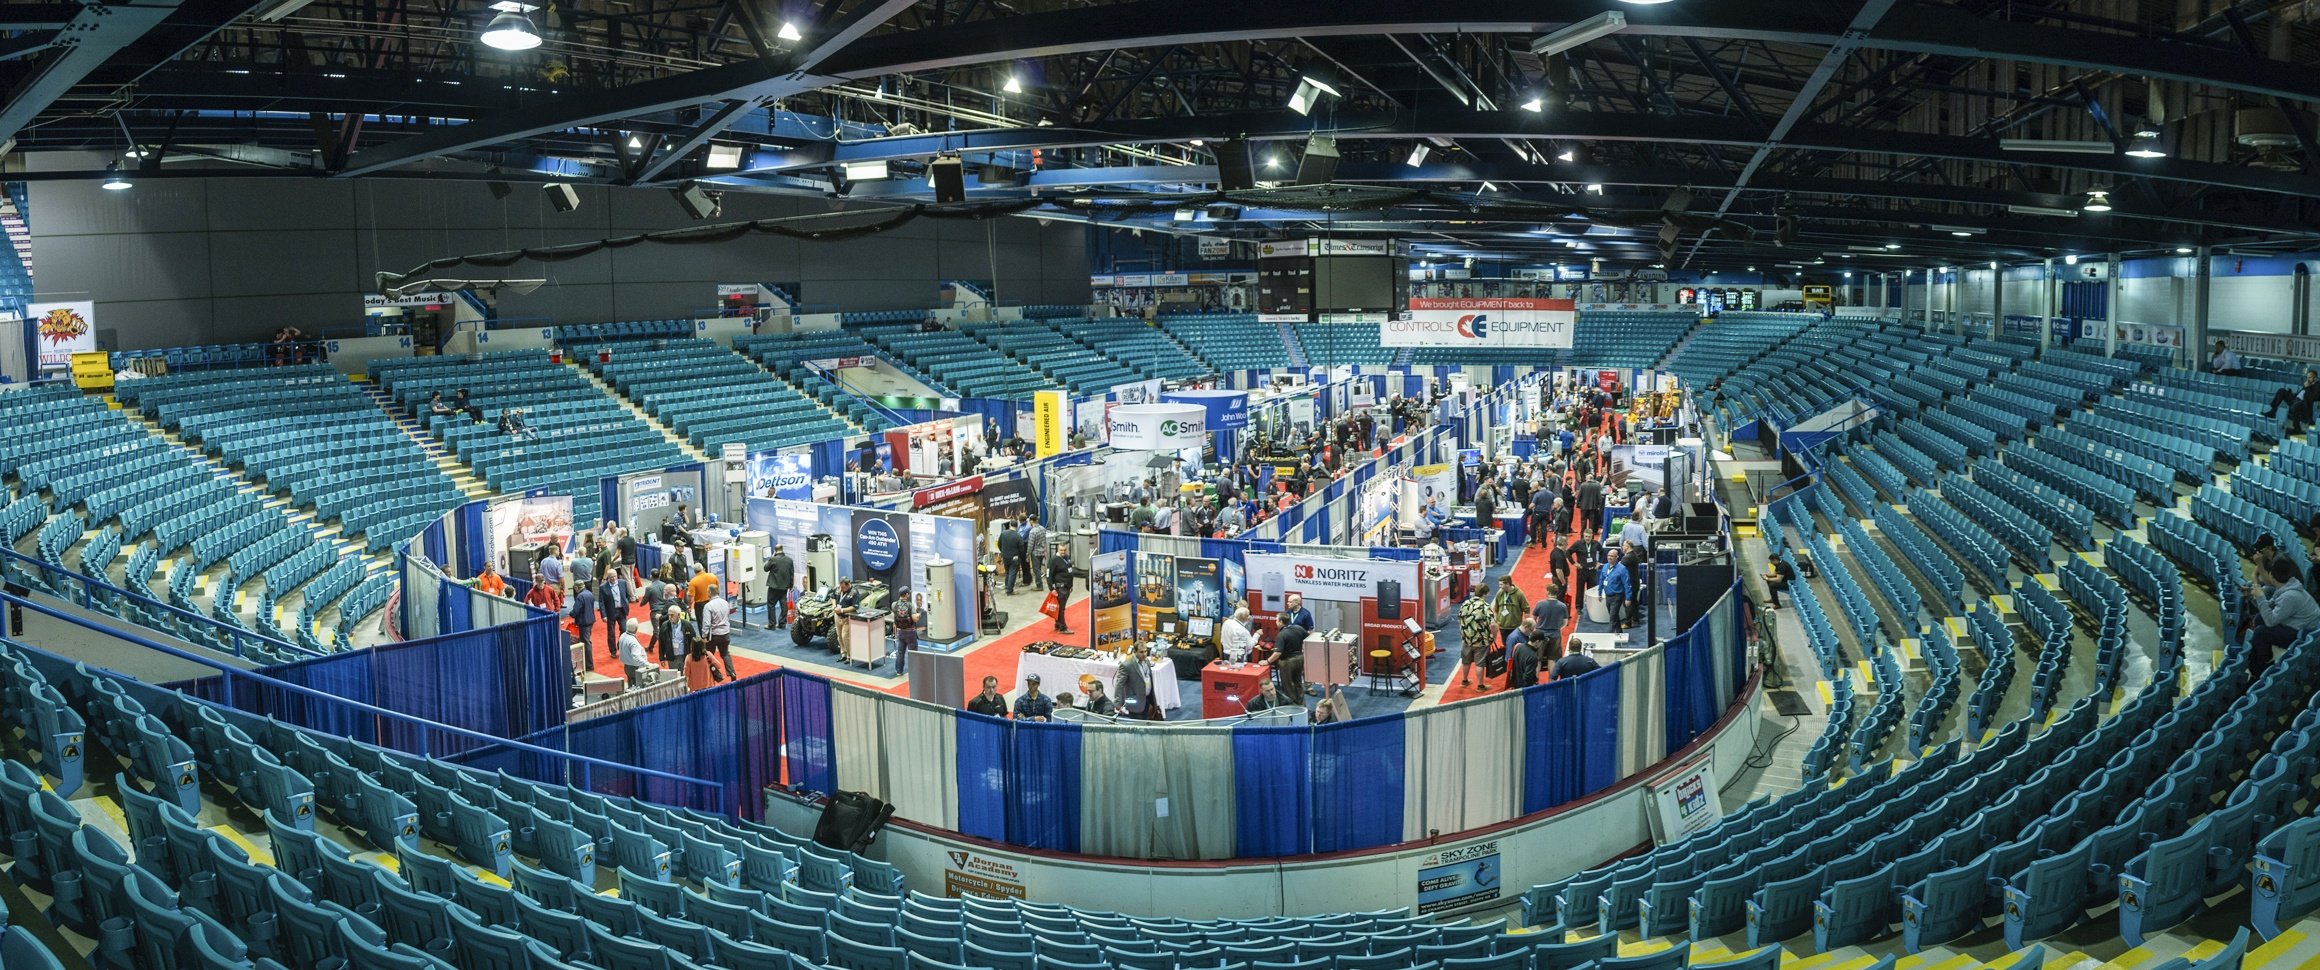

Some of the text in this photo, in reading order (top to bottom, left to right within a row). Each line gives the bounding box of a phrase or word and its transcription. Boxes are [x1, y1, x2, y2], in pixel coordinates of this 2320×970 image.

[365, 297, 392, 305] oday's
[414, 295, 436, 303] Music
[1420, 300, 1431, 308] We
[1433, 300, 1460, 310] brought
[1508, 300, 1524, 308] back
[698, 321, 706, 331] 13
[744, 319, 751, 327] 12
[1389, 321, 1454, 332] CONTROLS
[1491, 322, 1565, 333] EQUIPMENT
[477, 332, 488, 343] 14
[541, 329, 551, 339] 13
[326, 341, 339, 352] 15
[399, 337, 411, 348] 14
[2231, 335, 2282, 354] DELIVERING
[40, 353, 72, 364] WILDC
[1221, 413, 1236, 422] John
[1043, 413, 1051, 449] ENGINEERED
[1180, 421, 1203, 433] Smit
[756, 474, 805, 490] Dettson
[1317, 568, 1366, 582] NORITZ
[1295, 578, 1366, 589] TANKLESS WATER HEATERS
[1441, 841, 1497, 860] SKY ZONE
[1441, 848, 1497, 864] TRAMPOLINE PARK
[973, 856, 1013, 870] Dornan
[2260, 861, 2265, 869] K
[967, 861, 1018, 878] Academy
[948, 872, 988, 888] Motorcycle
[995, 883, 1023, 895] Spyder
[1421, 879, 1439, 887] COME
[951, 884, 1008, 901] Driver's Educat
